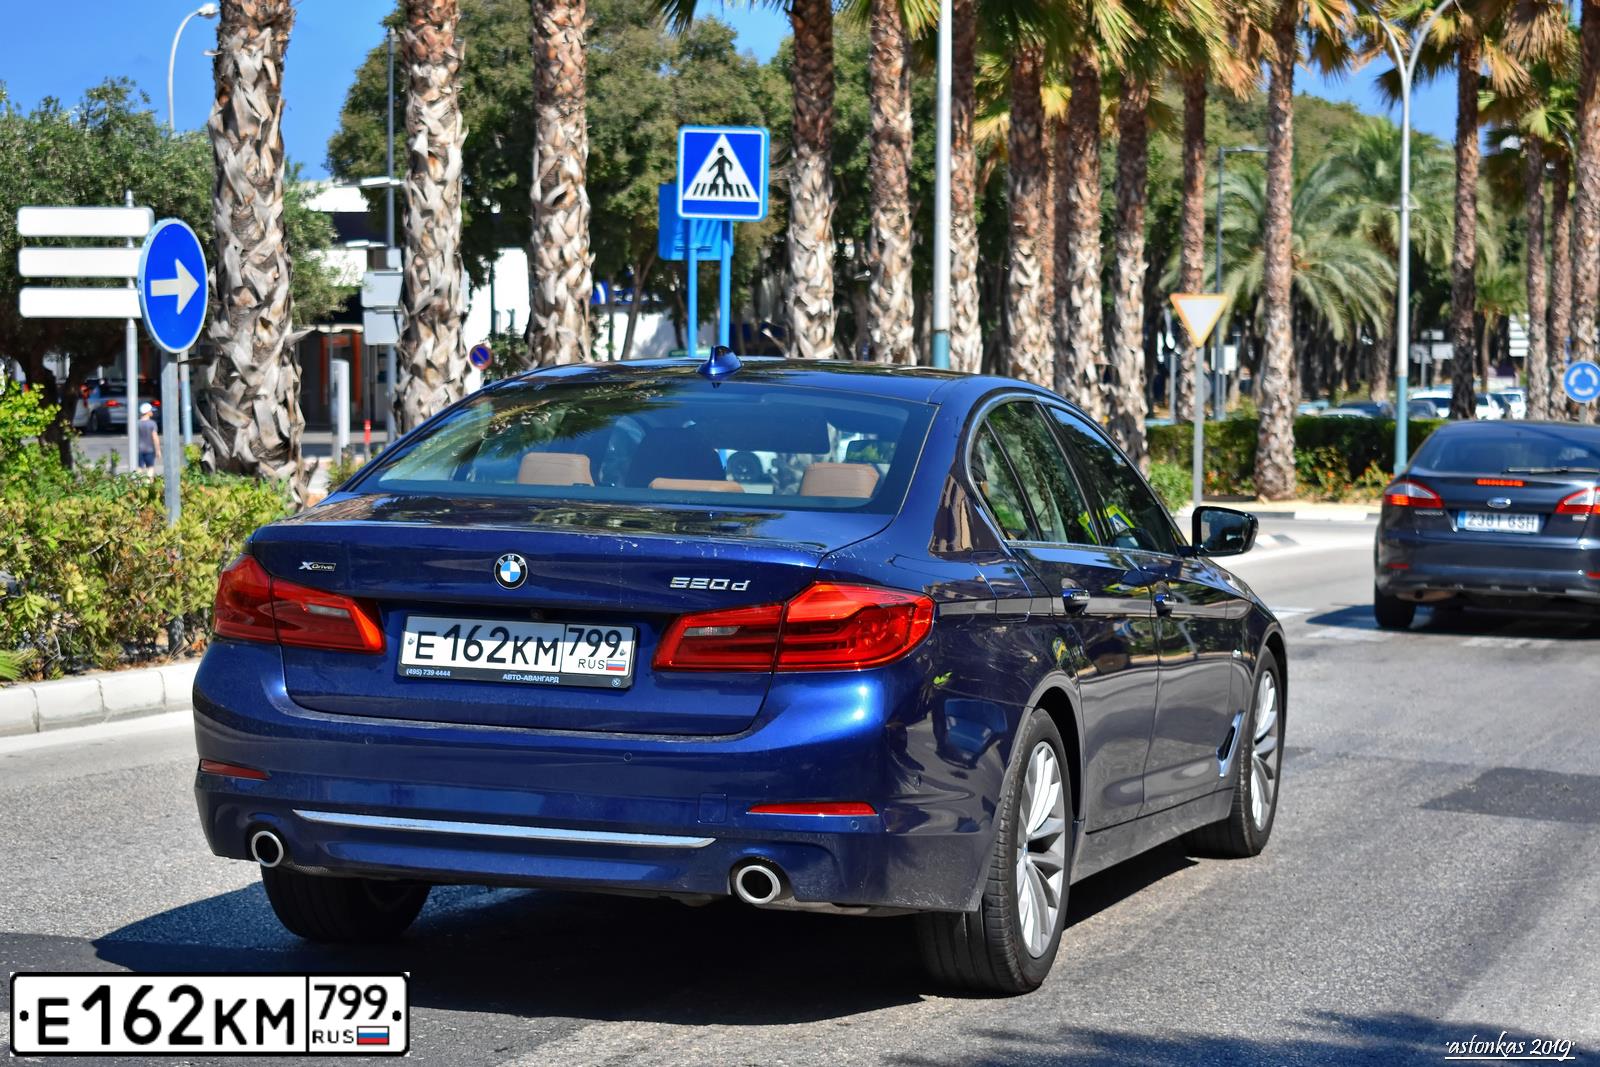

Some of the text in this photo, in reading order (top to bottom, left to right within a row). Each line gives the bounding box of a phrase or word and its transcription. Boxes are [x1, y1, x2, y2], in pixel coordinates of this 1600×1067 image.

[568, 627, 622, 658] 799
[577, 658, 605, 671] RUS
[406, 668, 423, 676] (495)
[502, 673, 560, 684] АВТО-АВАНГАРД
